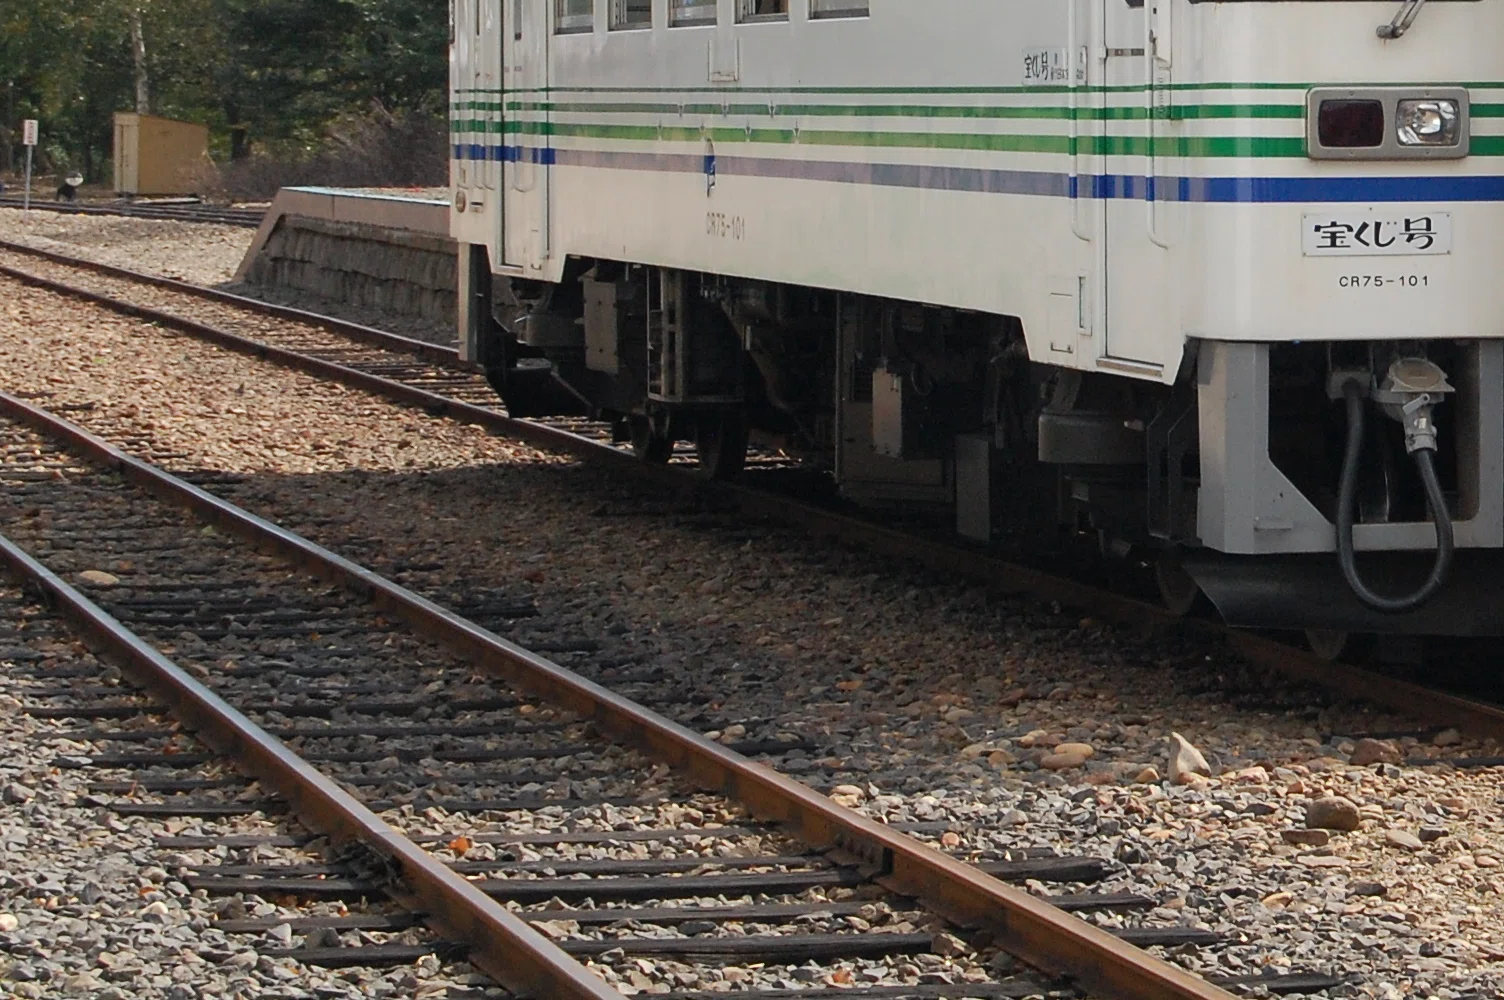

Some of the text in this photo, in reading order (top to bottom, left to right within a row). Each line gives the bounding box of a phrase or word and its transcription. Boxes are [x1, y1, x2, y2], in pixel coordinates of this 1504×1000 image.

[1313, 216, 1438, 250] 宝くじ号
[1338, 275, 1429, 288] CR75-101
